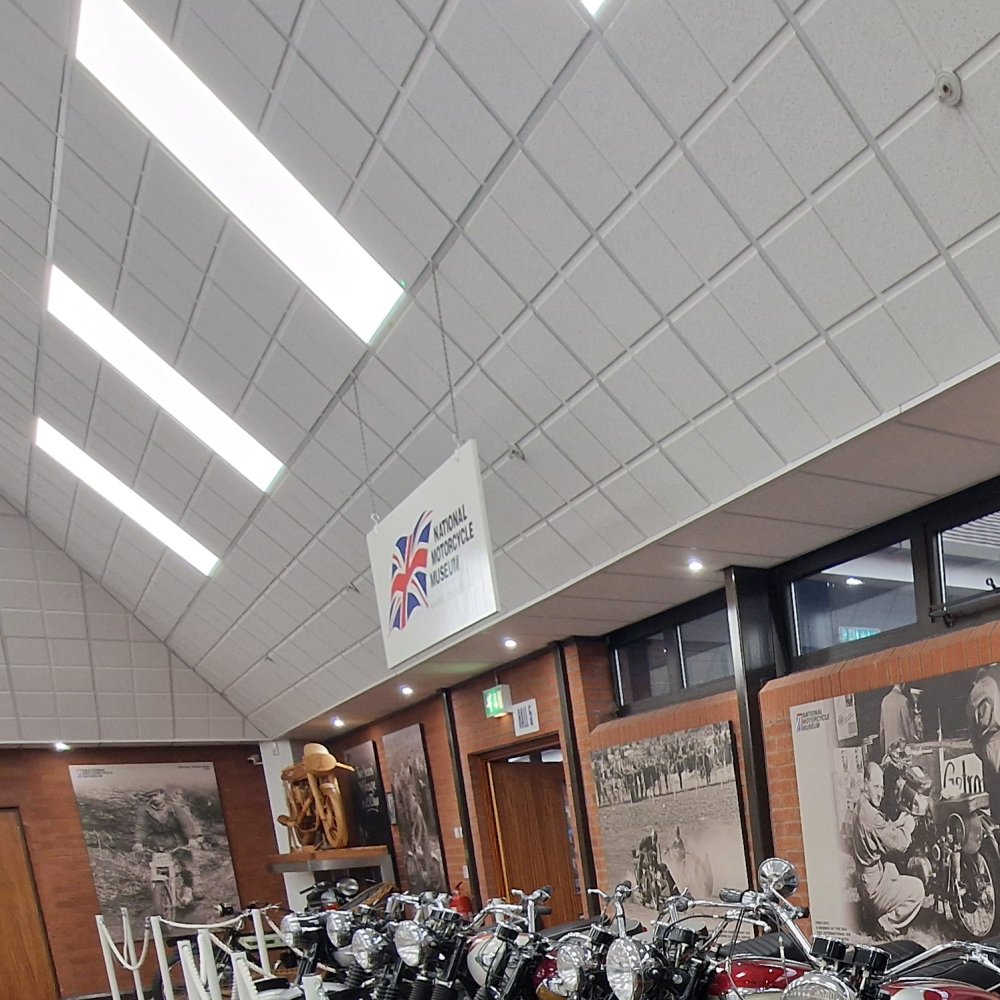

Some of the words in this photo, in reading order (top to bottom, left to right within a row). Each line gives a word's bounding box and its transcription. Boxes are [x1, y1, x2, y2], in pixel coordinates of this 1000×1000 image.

[431, 521, 475, 564] MOTORCYCLE
[433, 504, 468, 543] NATIONAL
[429, 555, 460, 589] MUSEUM
